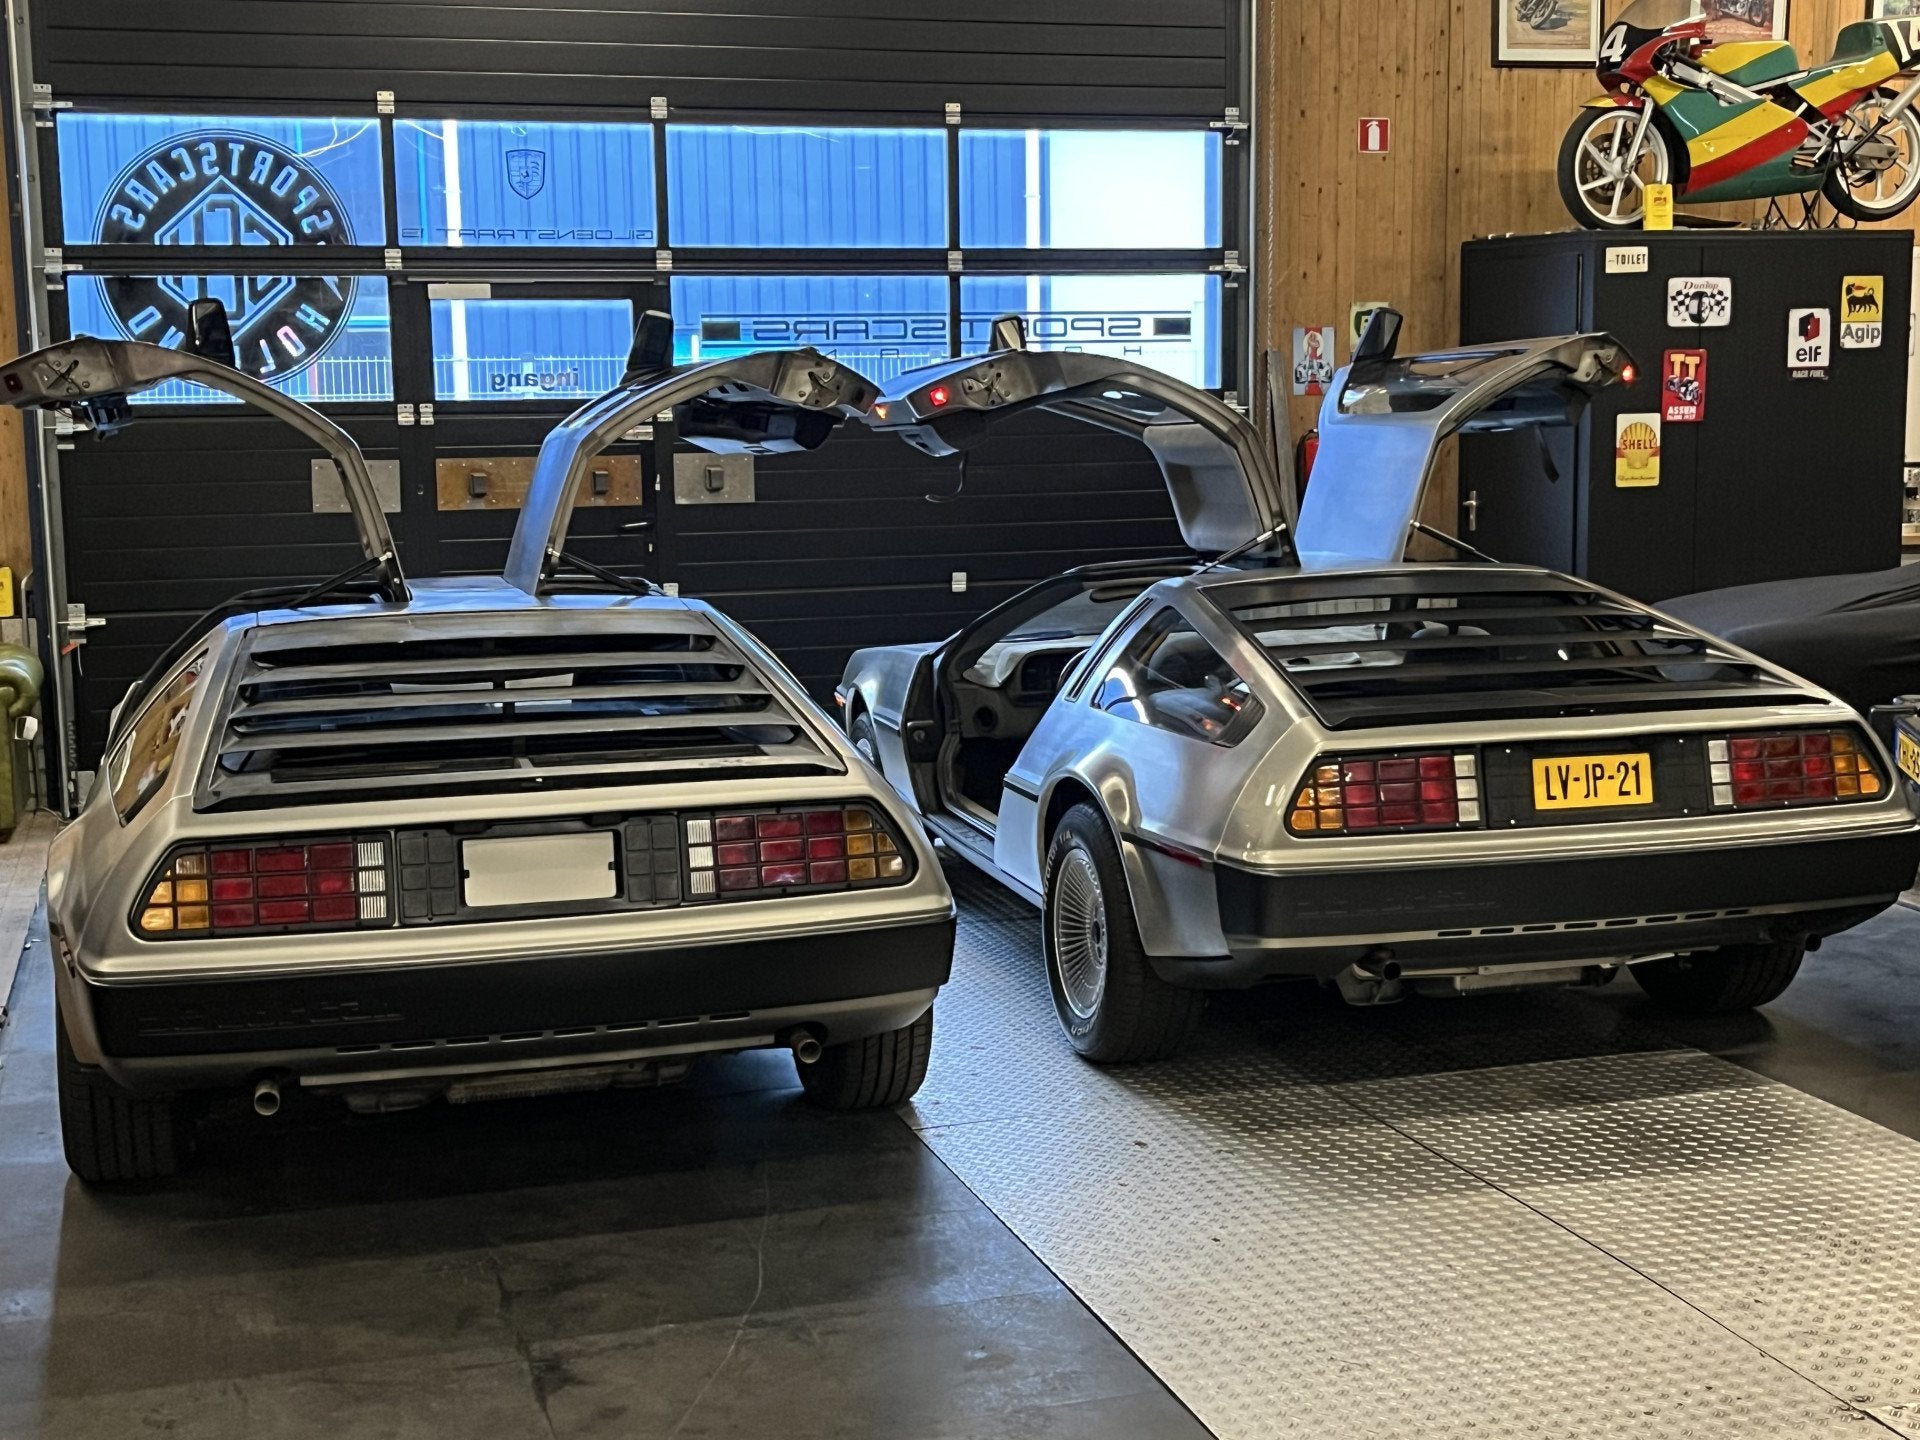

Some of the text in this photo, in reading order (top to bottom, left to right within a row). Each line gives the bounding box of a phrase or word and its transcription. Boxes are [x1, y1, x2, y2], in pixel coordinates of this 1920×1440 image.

[1616, 253, 1647, 265] TOILET
[1682, 280, 1719, 292] Dunlop
[1842, 324, 1881, 343] Agip
[1796, 346, 1822, 362] elf
[1670, 353, 1701, 379] TT
[1622, 439, 1654, 450] SHELL
[1544, 760, 1642, 801] LV-JP-21
